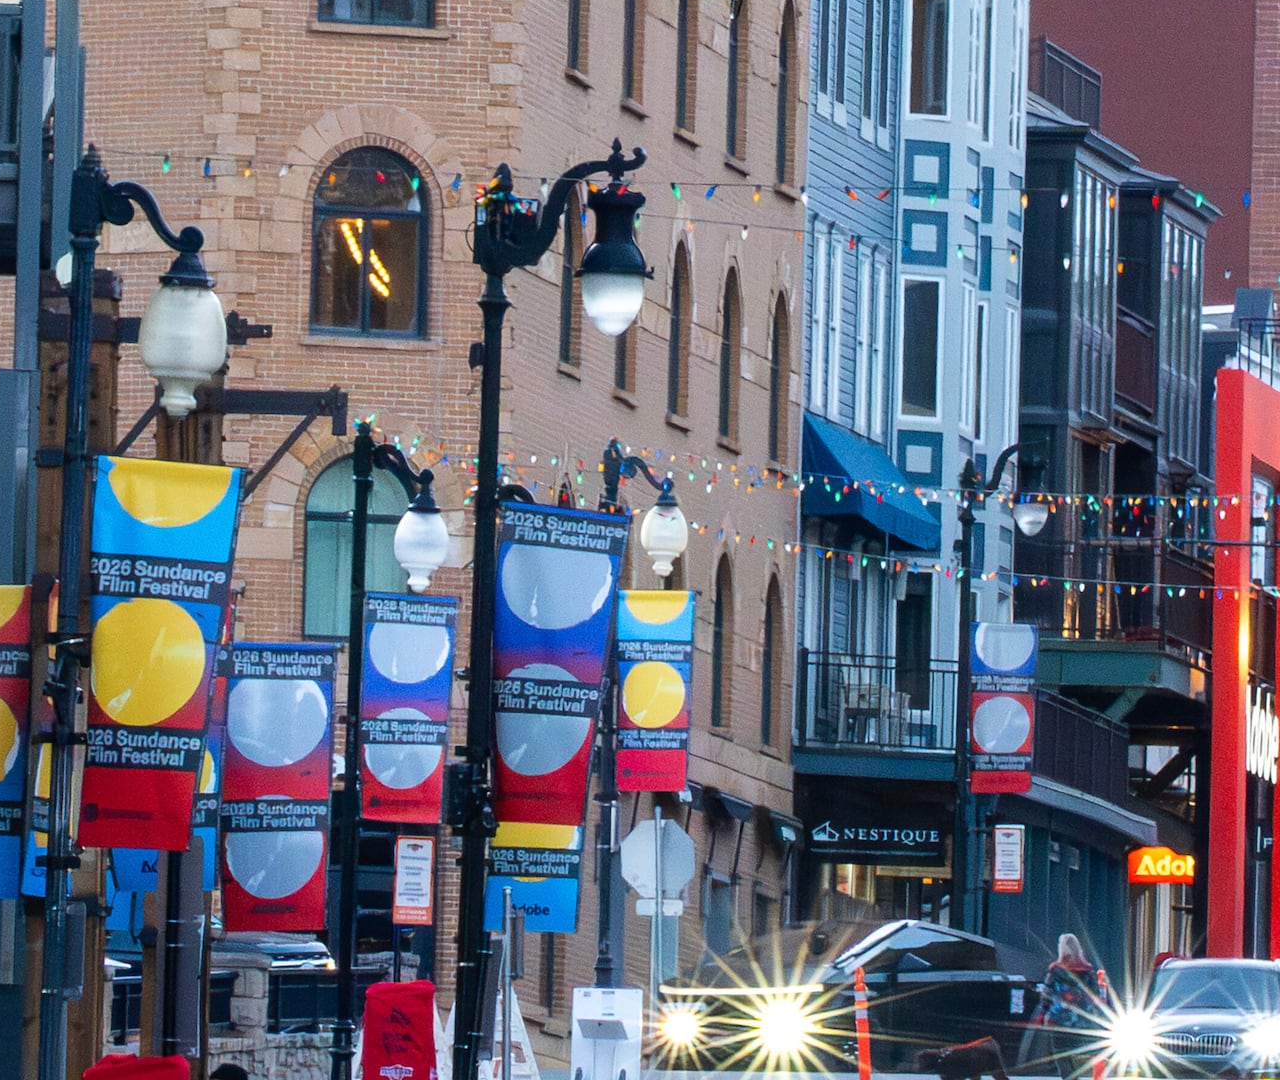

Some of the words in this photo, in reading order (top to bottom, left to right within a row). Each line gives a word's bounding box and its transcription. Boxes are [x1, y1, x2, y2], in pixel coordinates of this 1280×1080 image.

[504, 511, 544, 529] 2026
[546, 517, 623, 539] Sundance
[514, 527, 547, 542] Film
[551, 530, 611, 550] Festival
[135, 560, 226, 584] Sundance
[99, 575, 135, 594] Film
[139, 577, 210, 600] Festival
[233, 651, 259, 664] 026
[263, 651, 333, 666] Sundance
[235, 663, 265, 676] Film
[267, 663, 322, 677] Festival
[524, 681, 599, 701] Sundance
[498, 694, 526, 709] Film
[528, 696, 586, 713] Festival
[88, 729, 113, 746] 026
[116, 731, 201, 751] Sundance
[87, 747, 119, 764] Film
[121, 748, 185, 767] Festival
[222, 803, 253, 816] 2026
[257, 802, 328, 816] Sundance
[231, 815, 260, 828] Film
[263, 815, 316, 829] Festival
[844, 827, 940, 846] NESTIQUE
